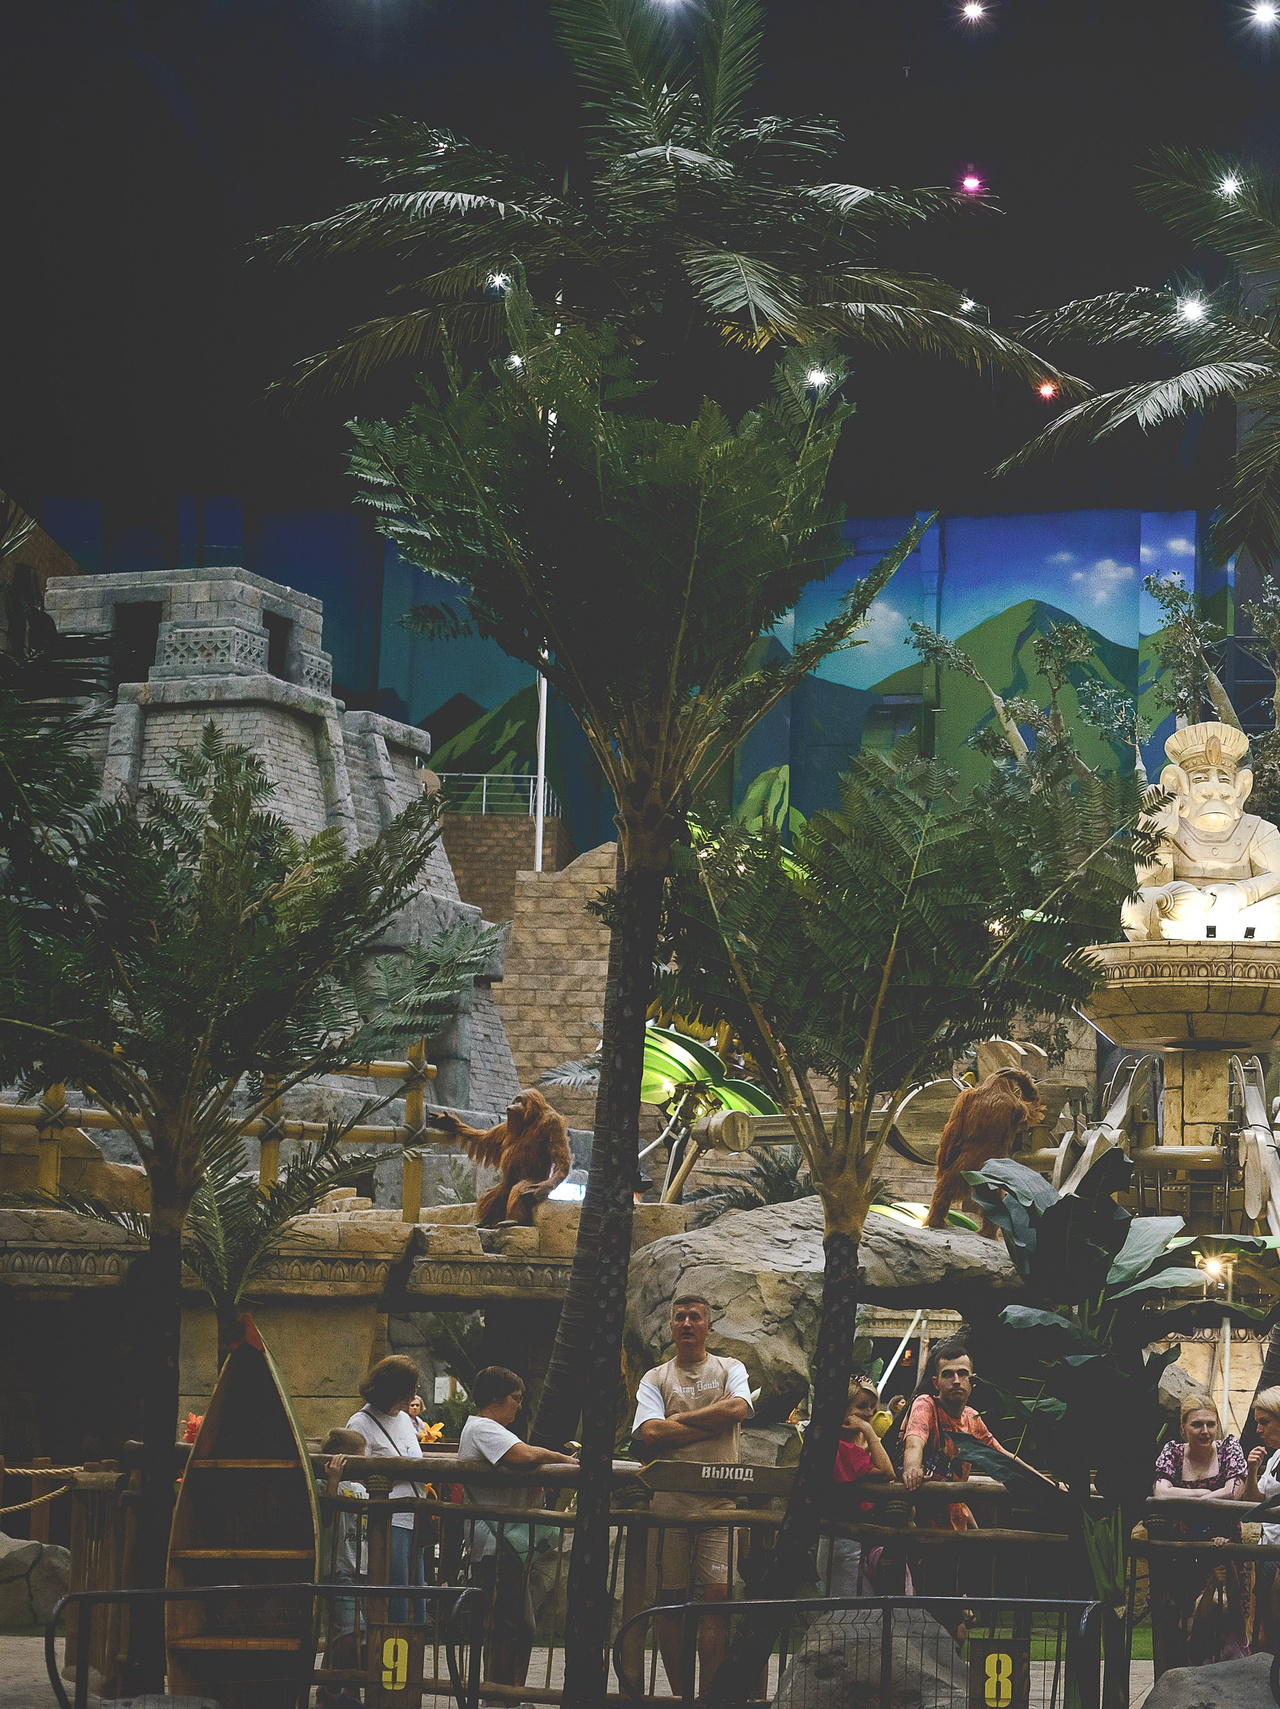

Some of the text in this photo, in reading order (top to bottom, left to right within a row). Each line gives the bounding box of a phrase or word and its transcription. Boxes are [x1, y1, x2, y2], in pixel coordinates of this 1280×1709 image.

[702, 1466, 754, 1482] ВЫХОД
[382, 1638, 408, 1690] 9
[985, 1653, 1012, 1708] 8
